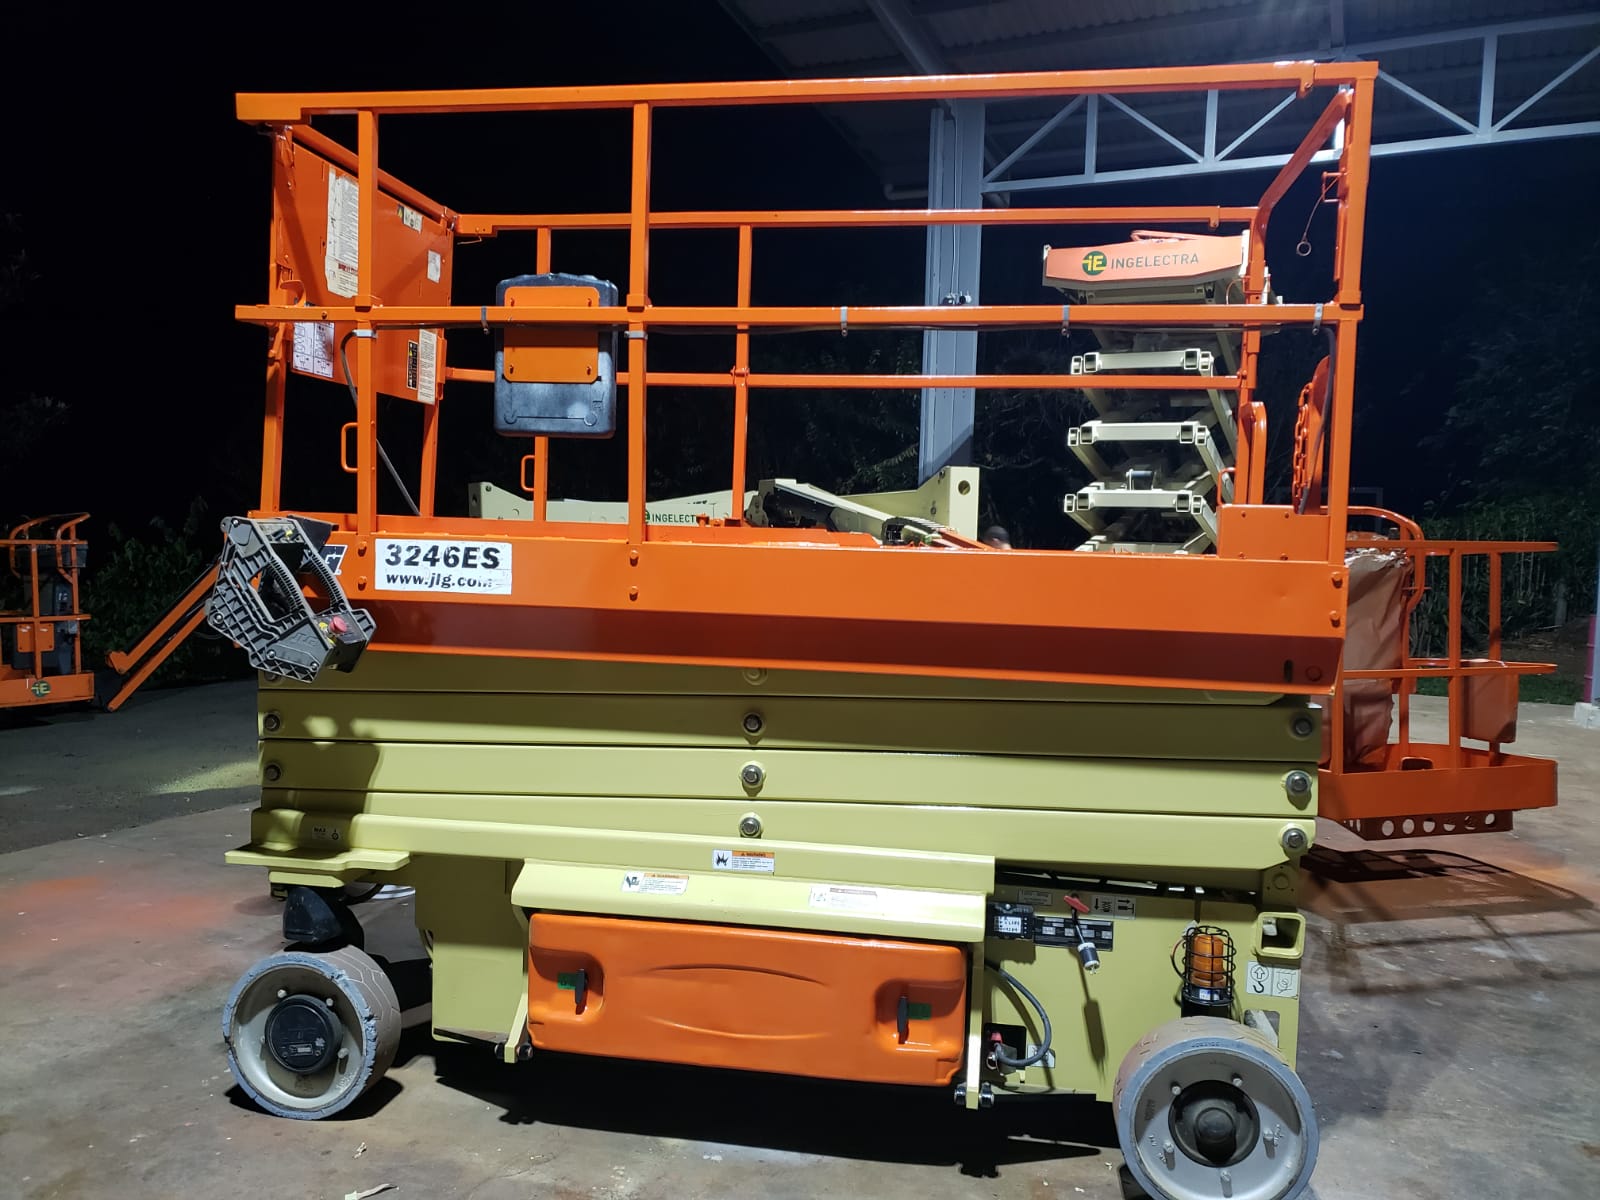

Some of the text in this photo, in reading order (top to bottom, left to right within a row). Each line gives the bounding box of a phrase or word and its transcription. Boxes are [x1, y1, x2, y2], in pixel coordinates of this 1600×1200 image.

[1111, 253, 1199, 270] INGELECTRA
[652, 513, 696, 523] INGELECT
[385, 543, 501, 570] 3246ES
